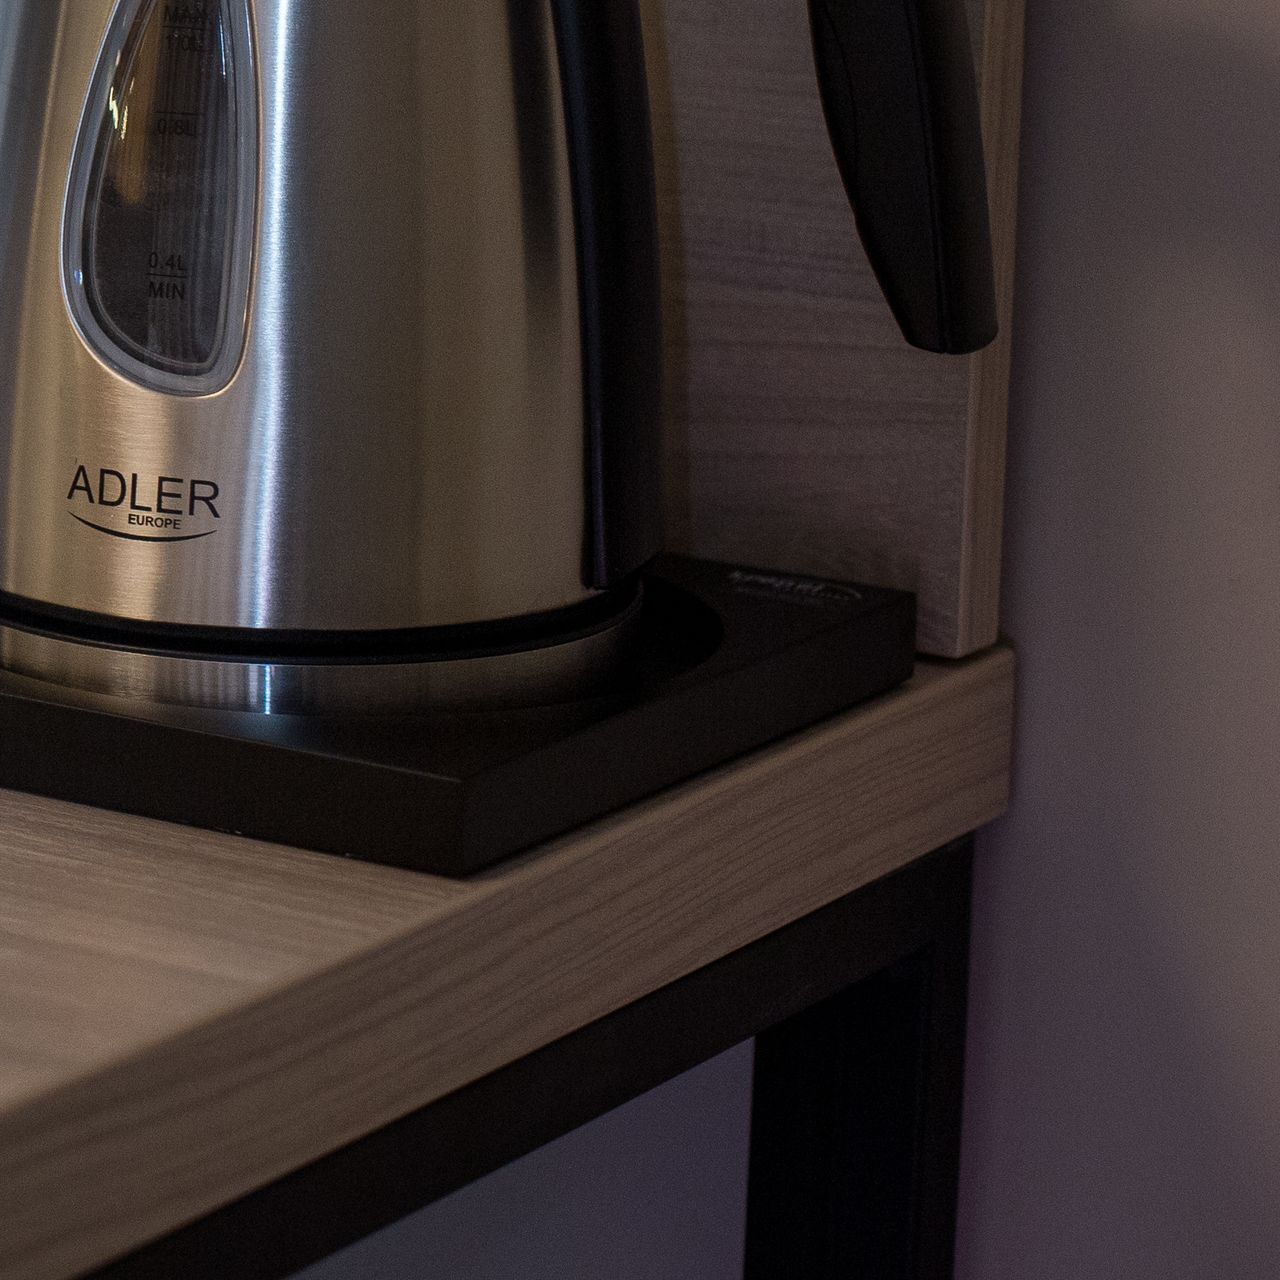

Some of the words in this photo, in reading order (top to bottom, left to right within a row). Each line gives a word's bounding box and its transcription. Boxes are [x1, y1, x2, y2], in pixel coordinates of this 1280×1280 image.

[147, 250, 188, 271] 0.4L
[147, 280, 187, 301] MIN
[66, 464, 221, 519] ADLER
[127, 513, 182, 530] EUROPE
